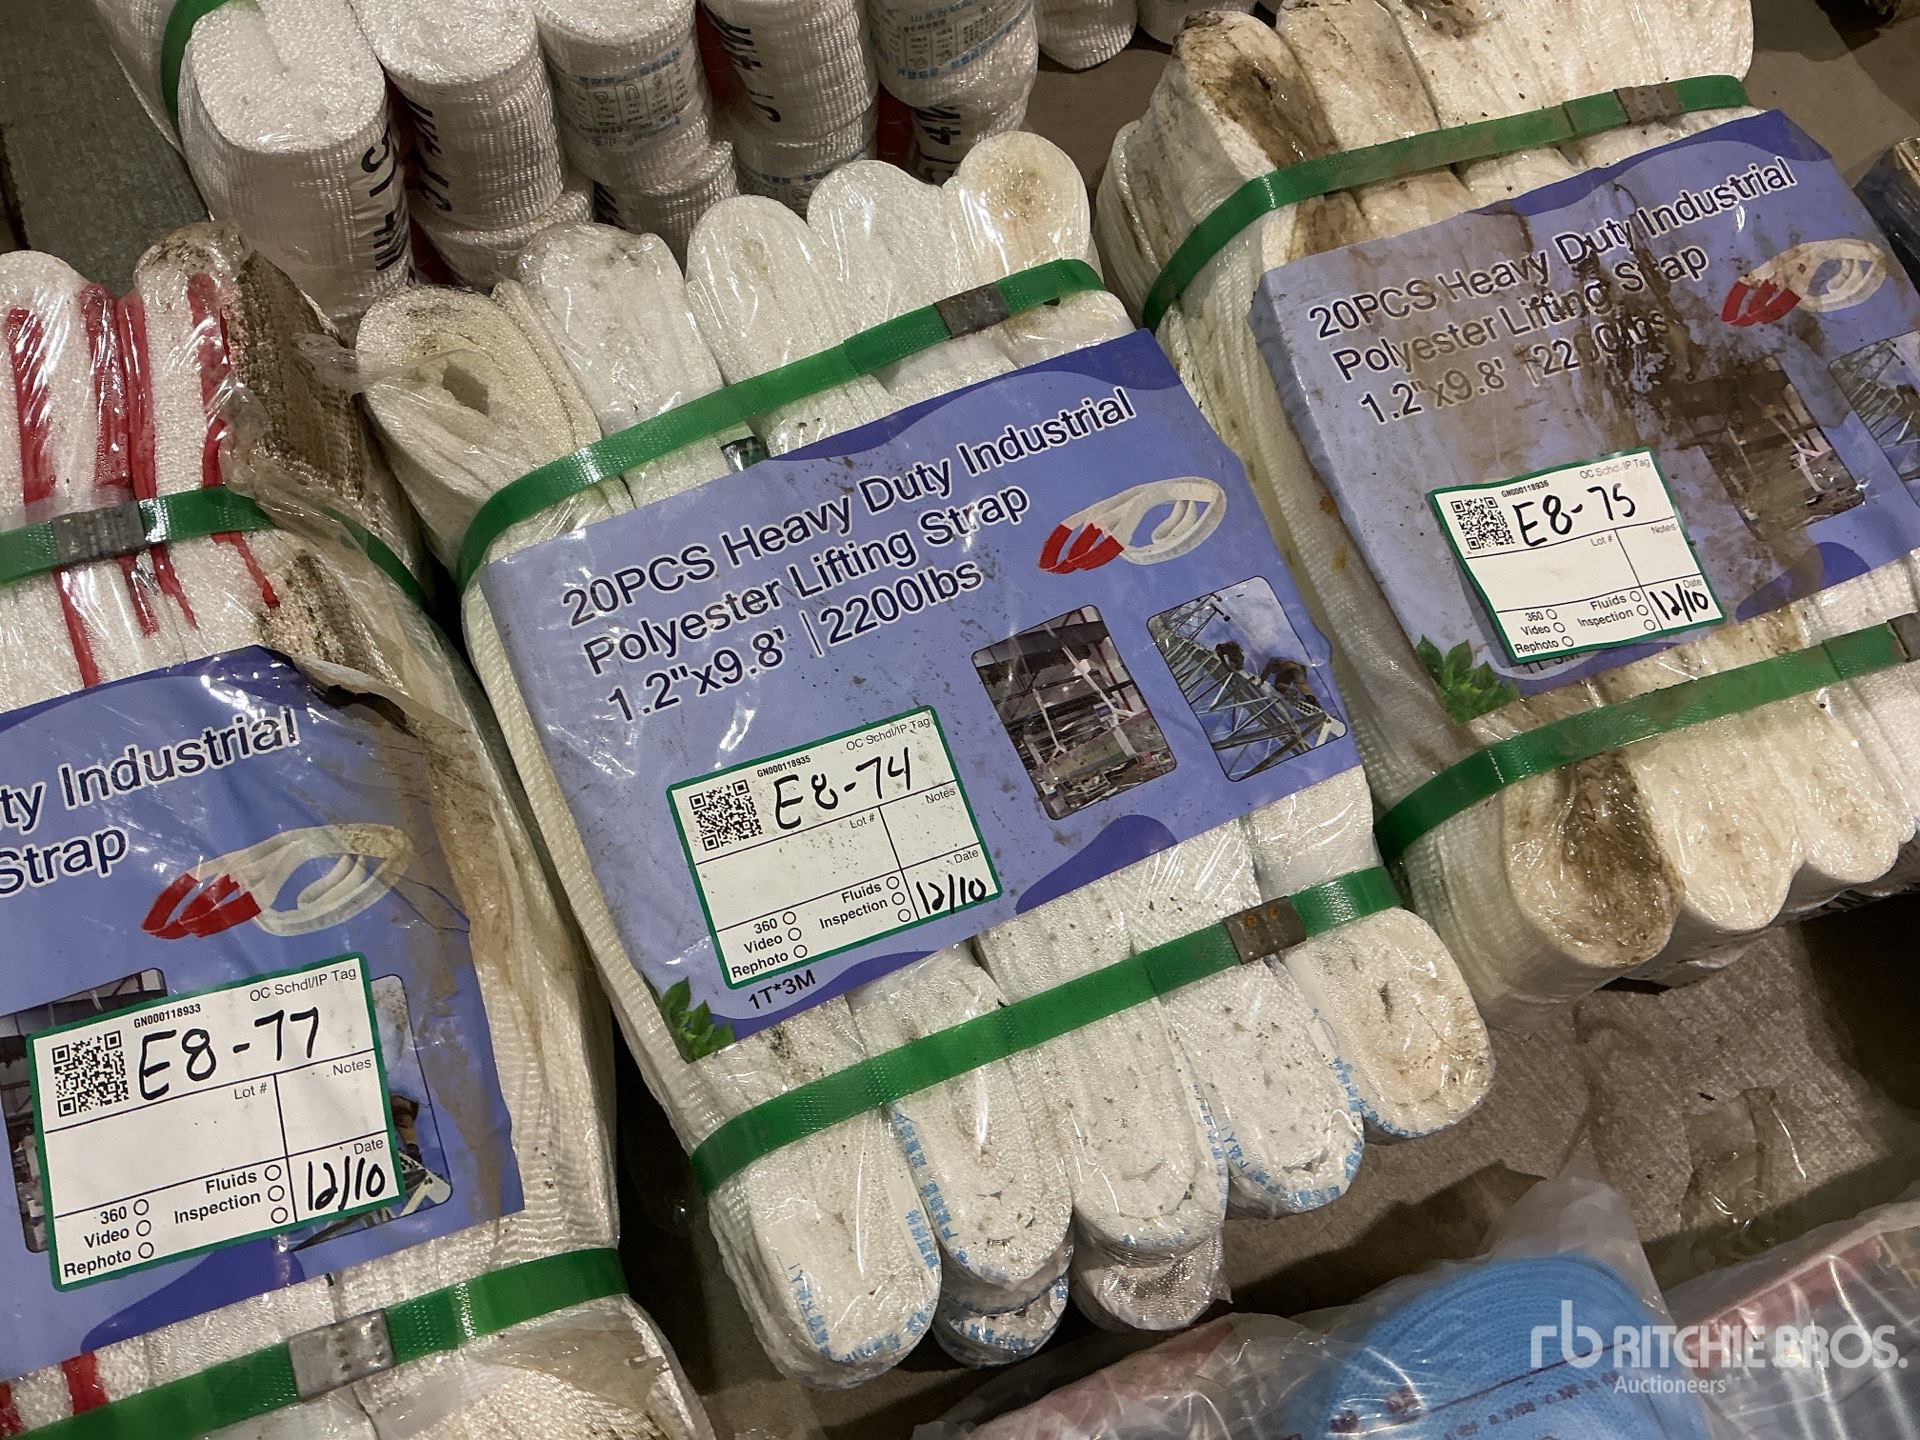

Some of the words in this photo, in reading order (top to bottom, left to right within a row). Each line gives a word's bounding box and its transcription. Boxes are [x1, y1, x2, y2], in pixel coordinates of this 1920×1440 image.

[1309, 279, 1437, 338] 20PCS
[1441, 250, 1548, 302] Heavy
[1555, 220, 1634, 265] Duty
[1637, 157, 1796, 237] Industrial
[1332, 314, 1496, 381] Polyester
[1614, 246, 1707, 292] Sap
[1580, 469, 1594, 480] OC
[1632, 458, 1651, 470] Tag
[563, 546, 715, 627] 20PCS
[724, 495, 850, 566] Heavy
[860, 459, 951, 516] Duty
[960, 388, 1134, 476] Industrial
[1512, 483, 1636, 547] E8-75
[1590, 536, 1606, 547] Lot
[1607, 534, 1614, 543] #
[1650, 523, 1678, 536] Notes
[584, 577, 782, 675] Polyester
[789, 528, 917, 599] Lifting
[921, 487, 1028, 549] Strap
[1683, 576, 1703, 589] Date
[1590, 593, 1627, 611] Fluids
[1650, 583, 1709, 622] 12/10
[1526, 611, 1544, 623] 360
[1577, 607, 1633, 628] Inspection
[1520, 623, 1551, 637] Video
[1514, 638, 1559, 655] Rephoto
[609, 627, 785, 724] 1.2"x9.8'
[846, 739, 864, 751] OC
[910, 717, 931, 731] Tag
[61, 708, 298, 806] Industrial
[756, 755, 811, 778] GN000118935
[774, 747, 911, 830] E8-74
[925, 787, 956, 804] Notes
[849, 817, 866, 829] Lot
[868, 814, 875, 823] #
[953, 849, 979, 864] Date
[841, 883, 882, 903] Fluids
[916, 873, 987, 914] 12/10
[819, 898, 888, 929] Inspection
[753, 918, 778, 934] 360
[744, 935, 783, 954] Video
[731, 950, 789, 978] Rephoto
[249, 988, 271, 1002] OC
[274, 973, 328, 996] Schdl/IP
[331, 967, 357, 984] Tag
[133, 1003, 201, 1028] GN000118933
[138, 1007, 319, 1100] E8-77
[332, 1057, 372, 1076] Notes
[233, 1086, 256, 1101] Lot
[258, 1082, 268, 1094] #
[353, 1138, 384, 1155] Date
[205, 1170, 258, 1194] Fluids
[307, 1155, 385, 1212] 12/10
[99, 1206, 128, 1225] 360
[174, 1190, 262, 1224] Inspection
[84, 1225, 130, 1249] Video
[63, 1248, 132, 1278] Rephoto
